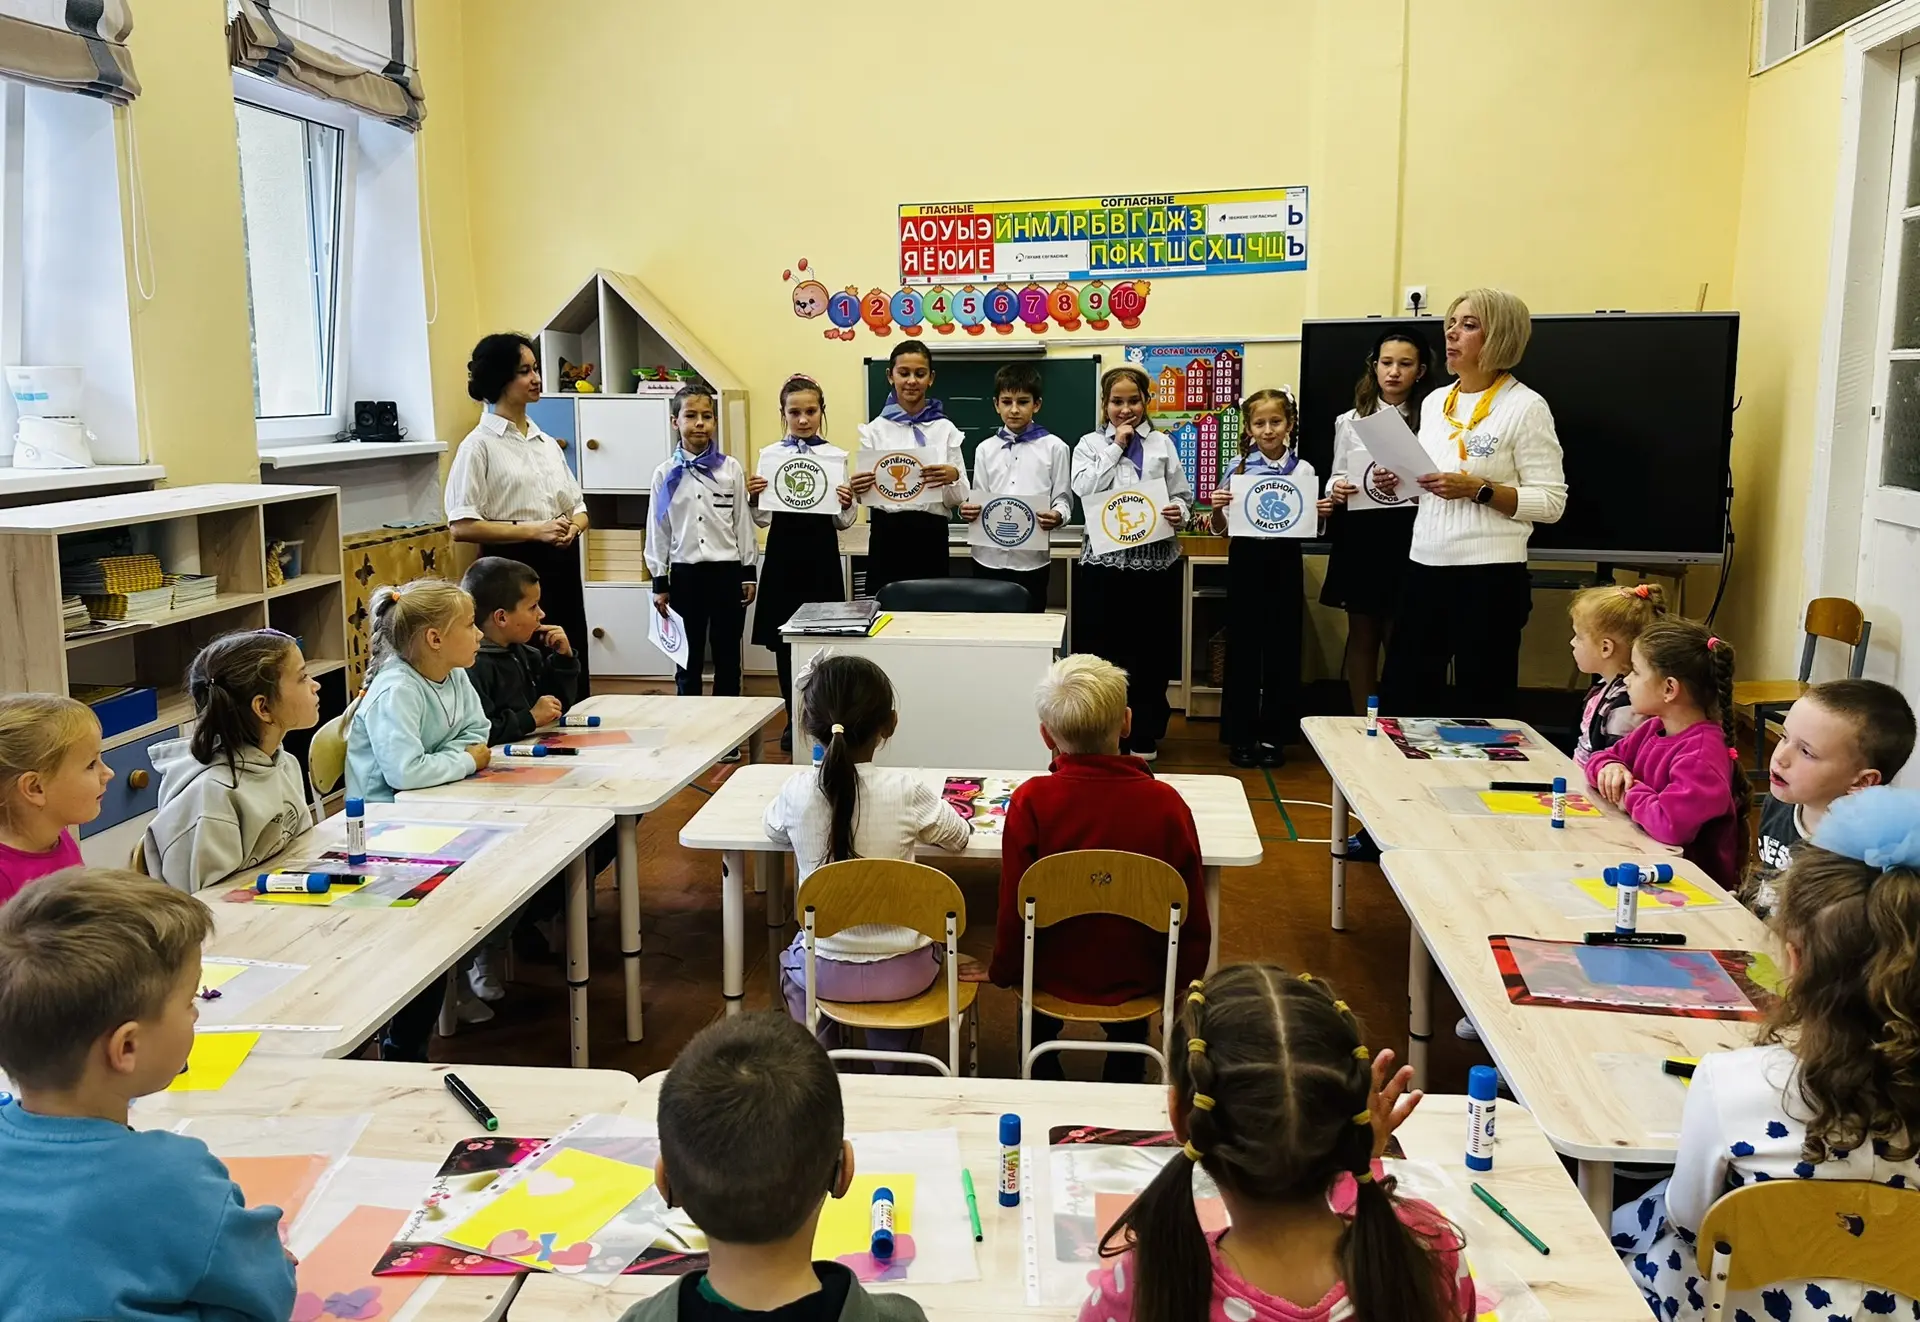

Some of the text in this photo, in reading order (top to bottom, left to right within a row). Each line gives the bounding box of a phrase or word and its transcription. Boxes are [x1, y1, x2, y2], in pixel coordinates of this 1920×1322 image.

[1101, 195, 1175, 208] СОГЛАСНЫЕ
[919, 204, 974, 215] ГЛАСНЫЕ
[1288, 205, 1303, 225] Ь
[1287, 236, 1304, 256] Ъ
[839, 287, 1138, 316] 1 2 3 4 5 6 7 8 9 10
[1152, 346, 1219, 356] СОСТАВ ЧИСЛА
[1221, 352, 1227, 361] 5
[1192, 361, 1198, 370] 4
[1165, 370, 1171, 378] 3
[1226, 407, 1235, 415] 10
[1206, 415, 1212, 424] 9
[1185, 424, 1191, 433] 8
[783, 461, 820, 474] ОРЛЁНОК
[880, 456, 917, 468] ОРЛЁНОК
[879, 482, 923, 498] СПОРТСМЕН
[1254, 481, 1294, 494] ОРЛЁНОК
[785, 495, 815, 506] ЭКОЛОГ
[1369, 488, 1399, 502] ДОБРОВ
[1108, 495, 1145, 511] ОРЛЁНОК
[1255, 519, 1290, 529] МАСТЕР
[1119, 529, 1146, 542] ЛИДЕР
[1007, 1160, 1017, 1190] STAFF
